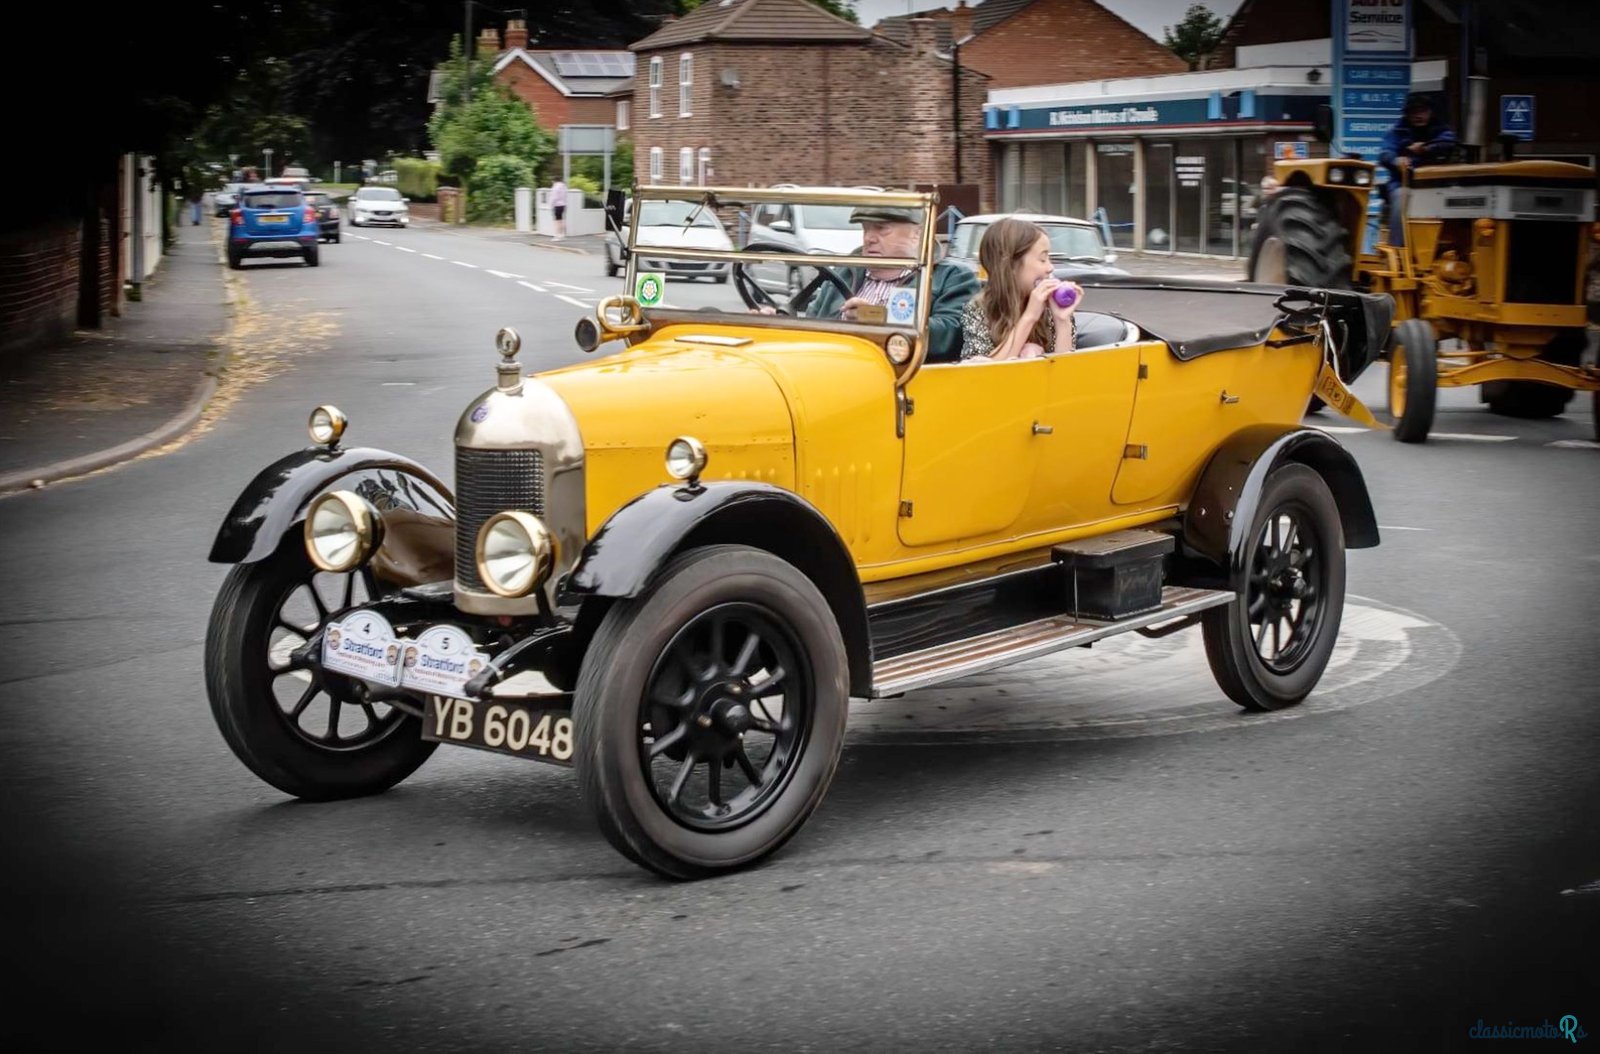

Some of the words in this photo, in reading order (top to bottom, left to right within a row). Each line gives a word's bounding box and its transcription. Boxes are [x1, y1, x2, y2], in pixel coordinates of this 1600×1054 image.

[362, 622, 372, 635] 4
[343, 637, 384, 660] Stratford
[441, 637, 450, 650] 5
[420, 653, 465, 675] Stratford
[433, 695, 474, 740] YB
[483, 704, 574, 761] 6048
